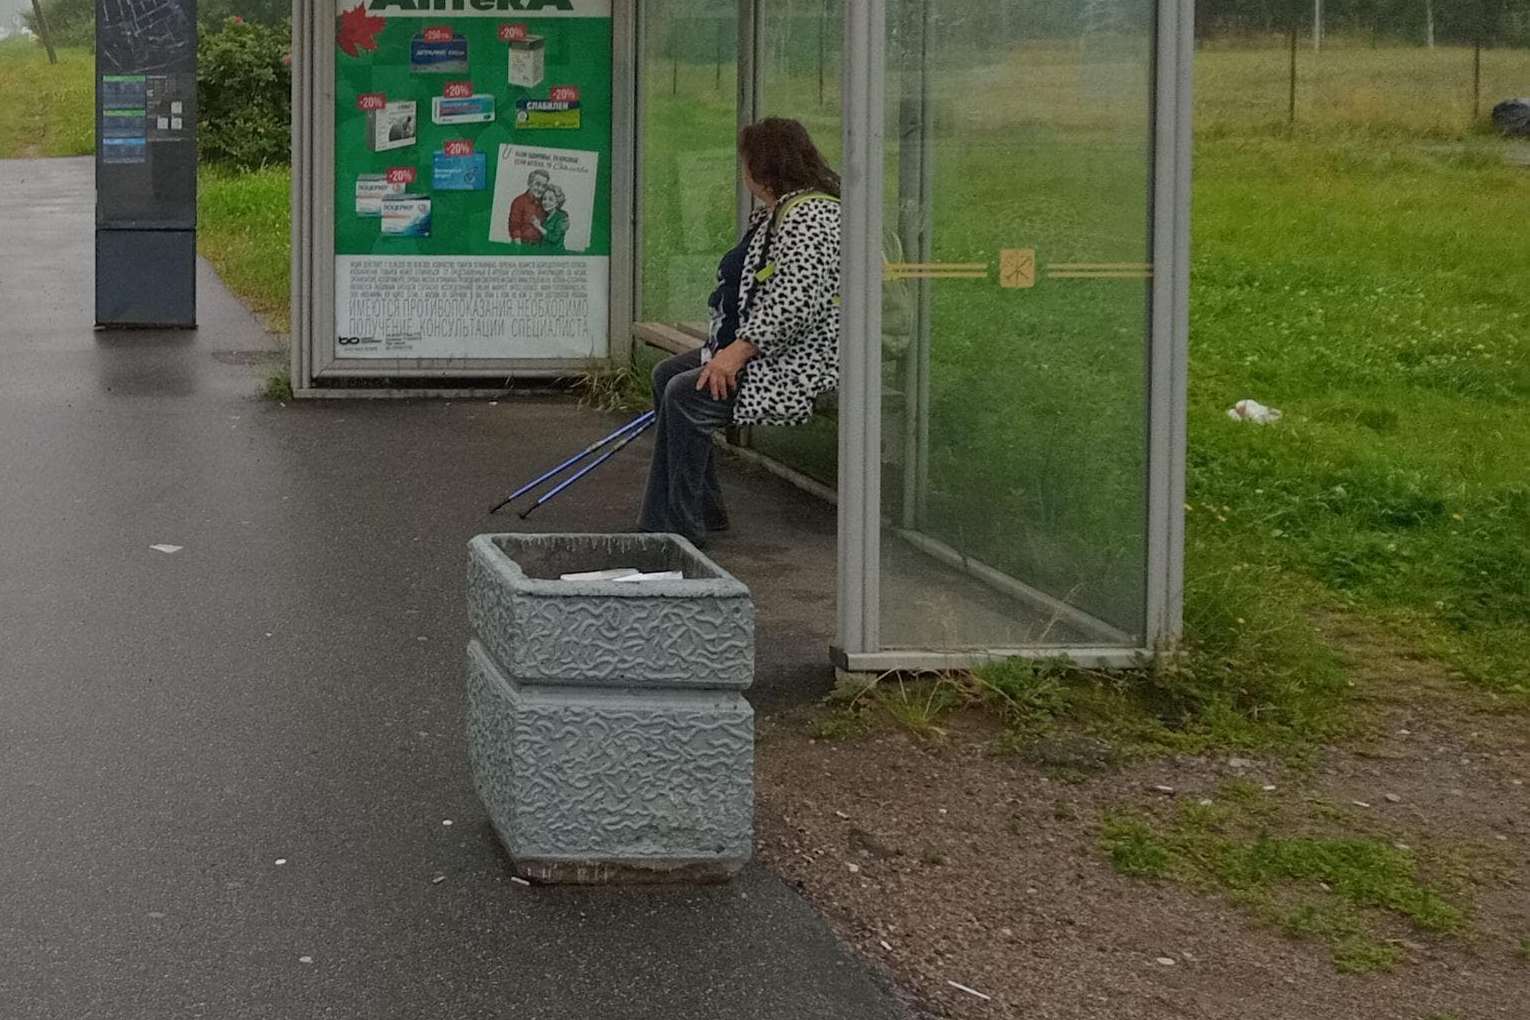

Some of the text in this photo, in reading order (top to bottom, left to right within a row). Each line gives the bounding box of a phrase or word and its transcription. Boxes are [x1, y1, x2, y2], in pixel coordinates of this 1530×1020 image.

[500, 27, 524, 38] -20%
[446, 84, 469, 96] -20%
[553, 88, 576, 99] -20%
[360, 97, 382, 108] -20%
[526, 102, 568, 110] СЛАБИЛЕН
[446, 142, 470, 154] -20%
[390, 170, 413, 181] -20%
[350, 299, 399, 317] ИМЕЮТСЯ
[517, 299, 588, 317] НЕОБХОДИМО
[349, 318, 588, 337] ПОЛУЧЕНИЕ КОНСУЛЬТАЦИИ СПЕЦИАЛИСТА
